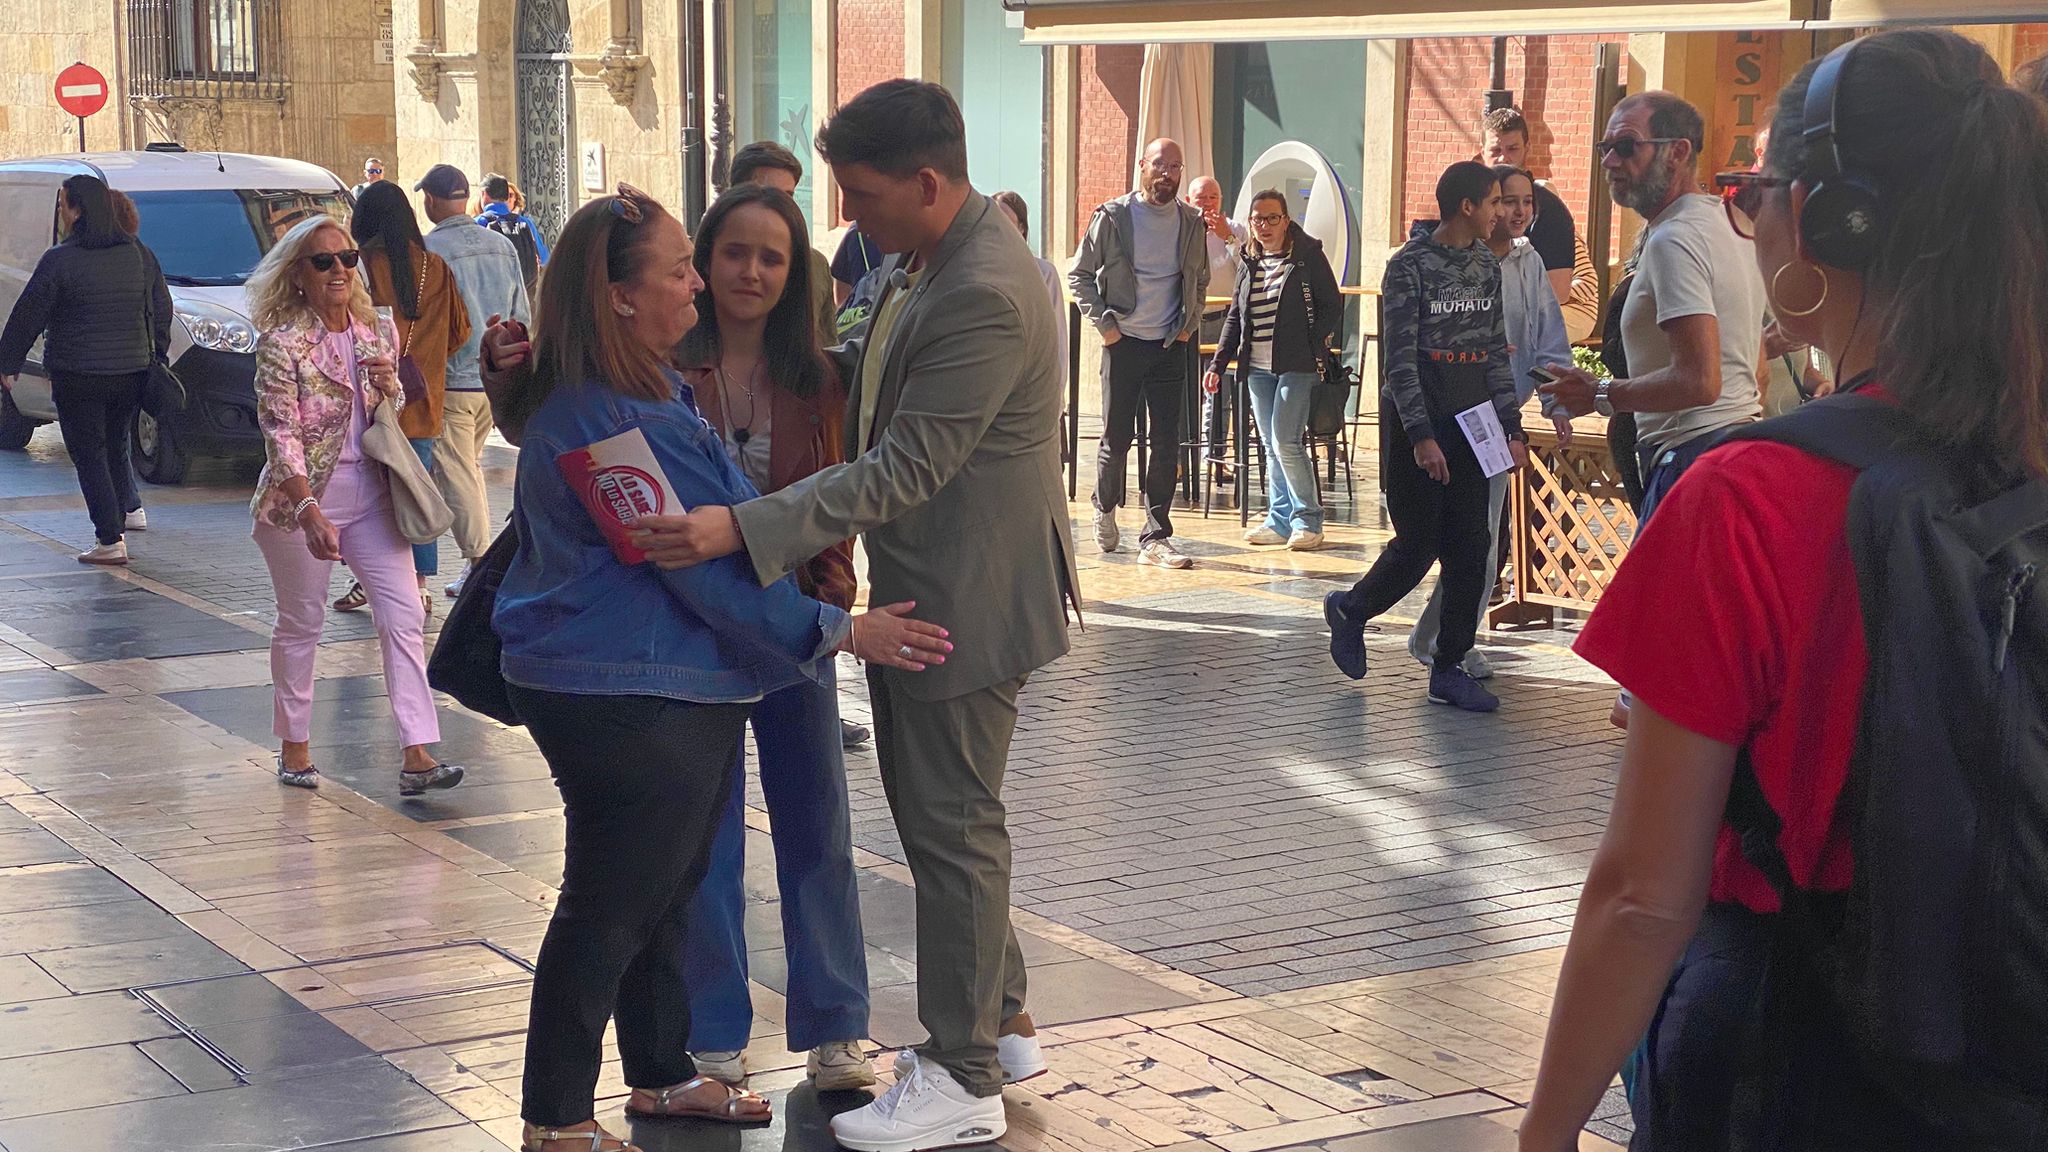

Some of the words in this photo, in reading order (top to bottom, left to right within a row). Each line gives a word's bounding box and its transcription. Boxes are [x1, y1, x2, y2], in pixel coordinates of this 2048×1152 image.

[1301, 281, 1312, 302] 1987
[595, 473, 614, 491] NO
[605, 489, 620, 500] LO
[620, 475, 638, 489] LO
